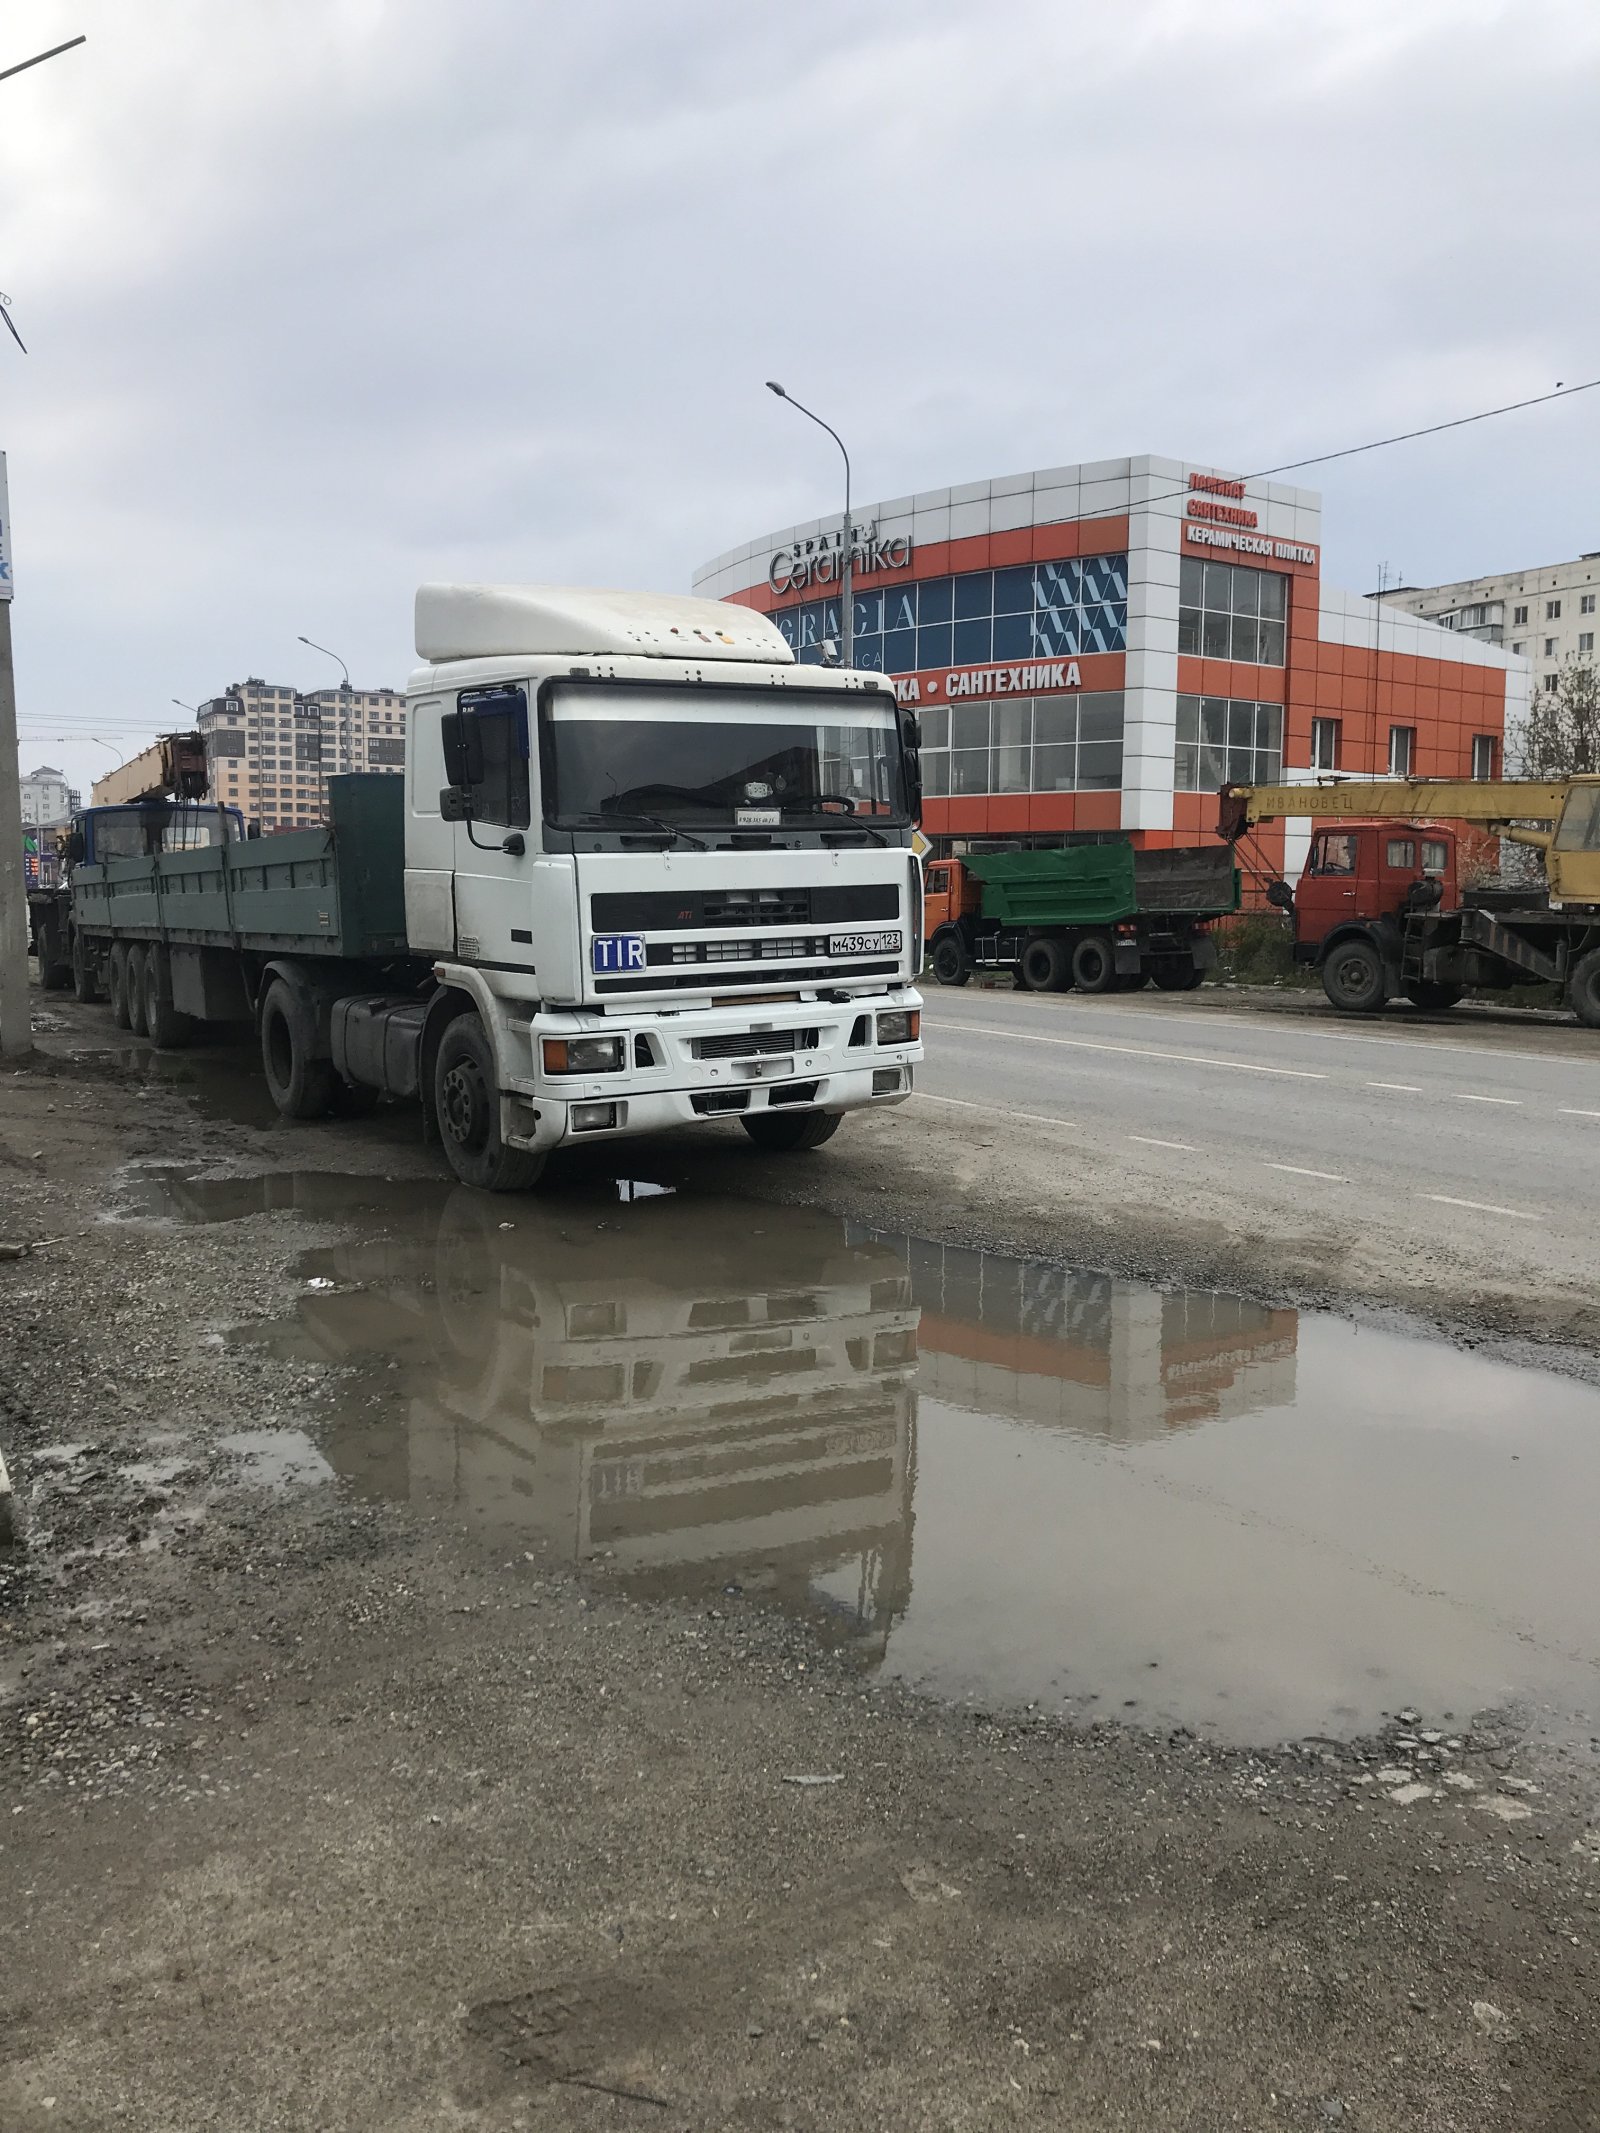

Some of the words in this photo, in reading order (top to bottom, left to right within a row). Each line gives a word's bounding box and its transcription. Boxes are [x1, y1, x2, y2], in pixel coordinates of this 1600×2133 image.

[1189, 473, 1246, 499] ЛАМИНАТ
[1187, 499, 1258, 527] САНТЕХНИКА
[1187, 525, 1273, 556] КЕРАМИЧЕСКАЯ
[1275, 542, 1316, 564] ПЛИТКА
[779, 594, 916, 648] GRACIA
[945, 662, 1081, 697] САНТЕХНИКА
[1266, 796, 1353, 809] ИВАНОВЕЦ
[882, 933, 899, 945] 123
[598, 940, 644, 967] TIR
